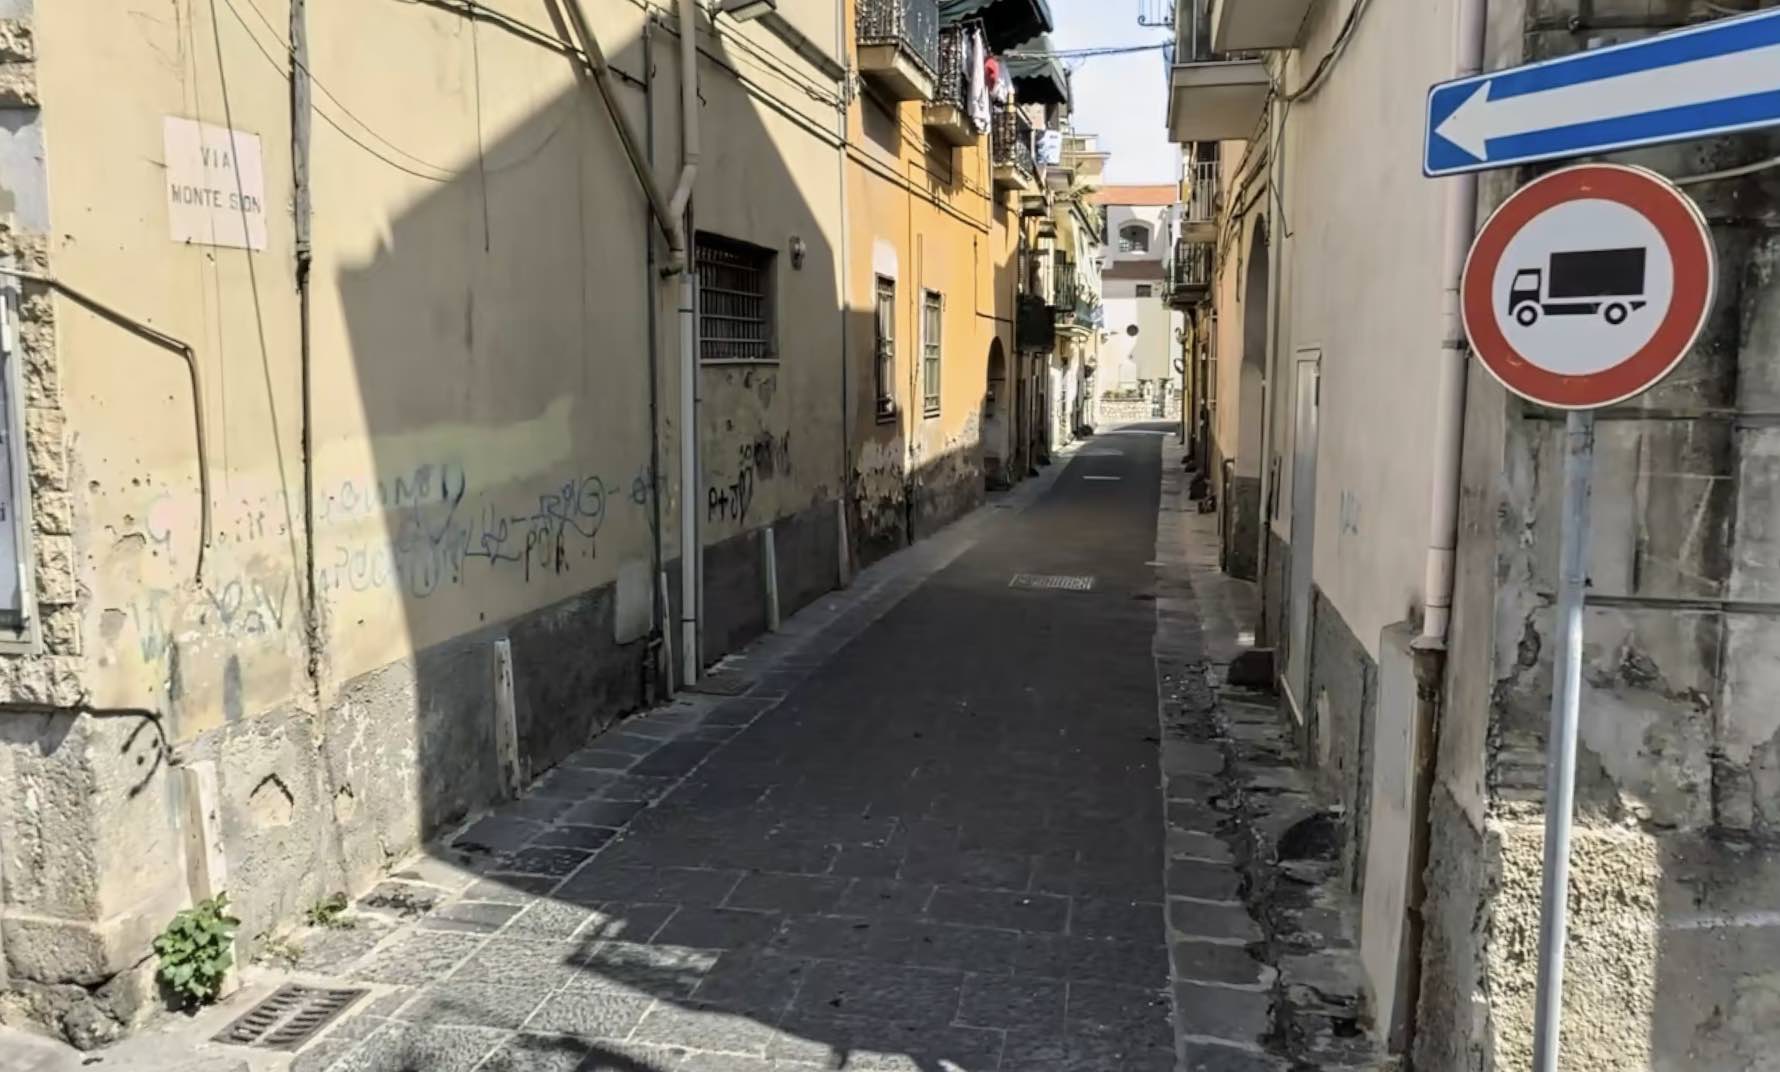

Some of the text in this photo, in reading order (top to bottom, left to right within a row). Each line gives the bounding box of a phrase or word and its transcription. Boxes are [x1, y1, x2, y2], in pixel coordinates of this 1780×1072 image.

[200, 146, 231, 168] VIA
[171, 183, 261, 214] MONTE SON
